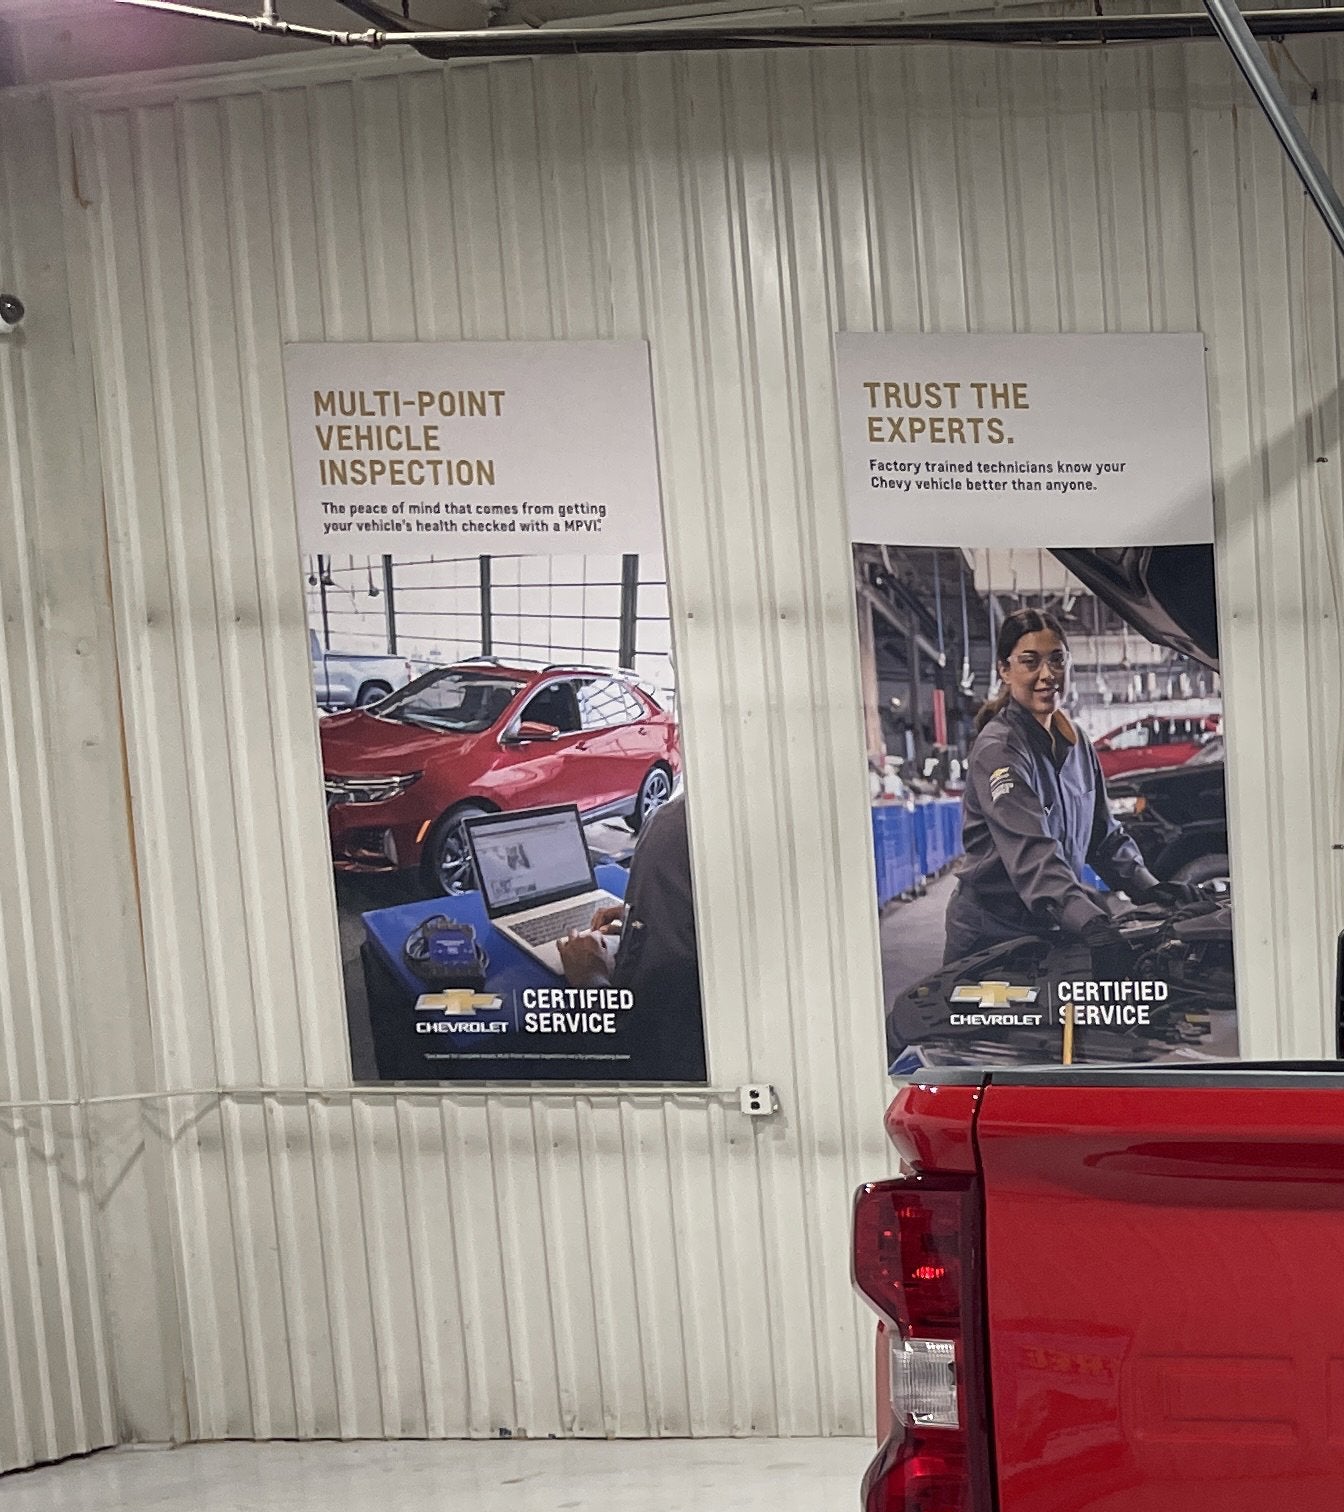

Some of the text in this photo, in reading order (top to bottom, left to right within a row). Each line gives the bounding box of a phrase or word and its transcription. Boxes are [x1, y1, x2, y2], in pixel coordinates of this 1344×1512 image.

[313, 390, 506, 417] MULTI-POINT
[863, 382, 1029, 409] TRUST THE
[315, 425, 441, 451] VEHICLE
[867, 417, 1015, 444] EXPERTS.
[319, 459, 496, 486] INSPECTION
[870, 459, 1126, 477] Factory trained technicians know your
[871, 477, 1098, 494] Chevy vehicle better than anyone.
[322, 502, 606, 517] The peace of mind that comes from getting
[323, 522, 352, 534] your
[356, 519, 413, 532] vehicle's
[416, 519, 457, 532] health
[461, 519, 515, 533] checked
[519, 520, 549, 532] with
[553, 523, 560, 532] a
[523, 989, 634, 1010] CERTIFIED
[1058, 981, 1168, 1001] CERTIFIED
[415, 1022, 509, 1033] CHEVROLET
[525, 1013, 616, 1033] SERVICE
[950, 1014, 1042, 1026] CHEVROLET
